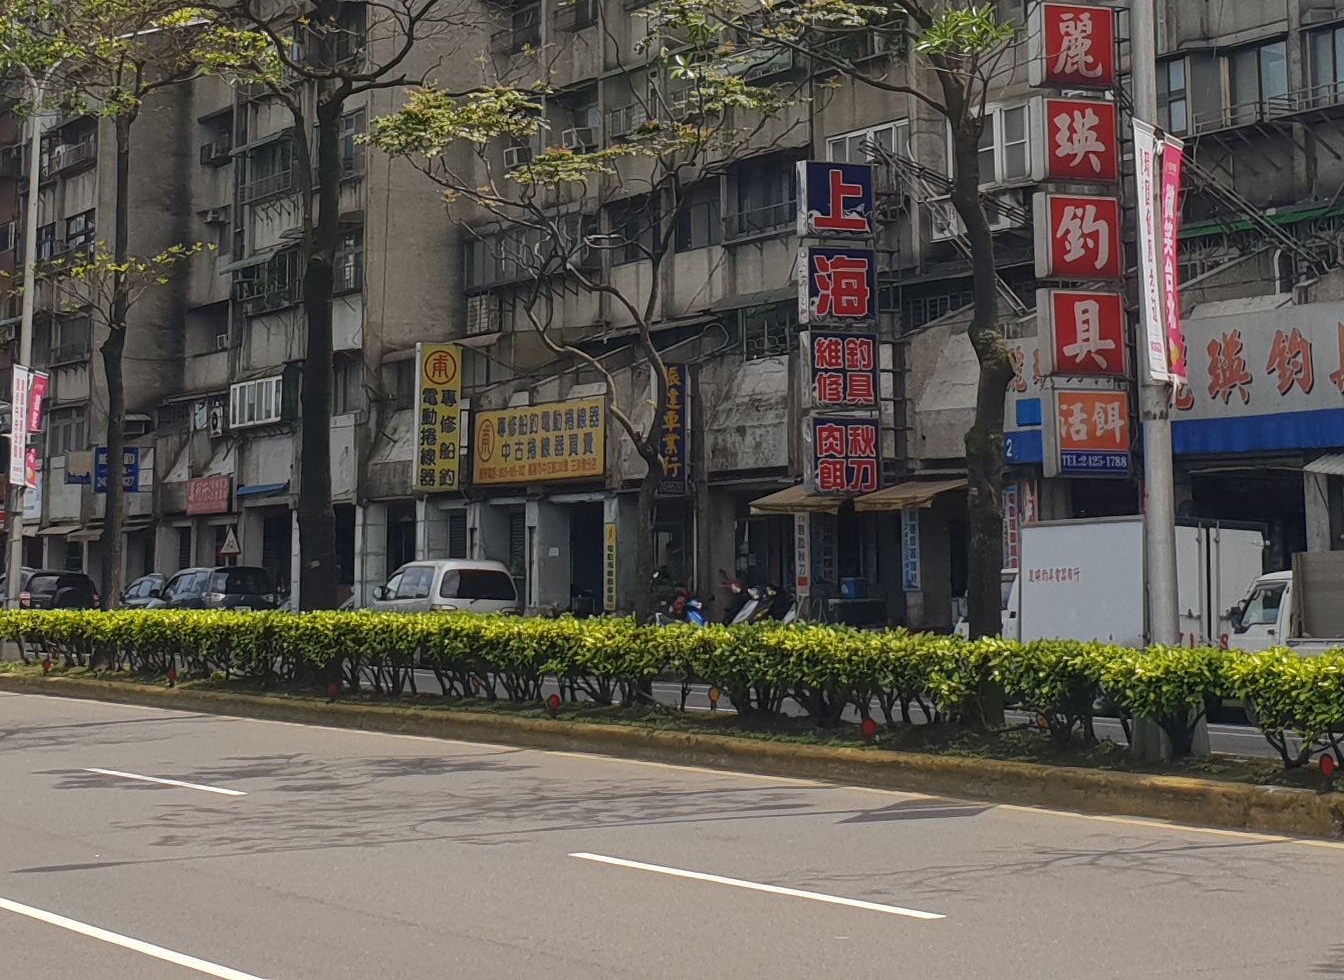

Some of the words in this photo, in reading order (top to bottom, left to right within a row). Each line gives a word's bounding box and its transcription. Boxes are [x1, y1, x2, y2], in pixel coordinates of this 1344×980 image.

[1053, 11, 1116, 369] 麗瑛釣具
[813, 169, 870, 318] 上海
[815, 337, 843, 404] 維修
[845, 337, 874, 405] 釣具
[1060, 402, 1125, 442] 活餌
[817, 423, 846, 491] 肉餌
[848, 424, 878, 491] 秋刀
